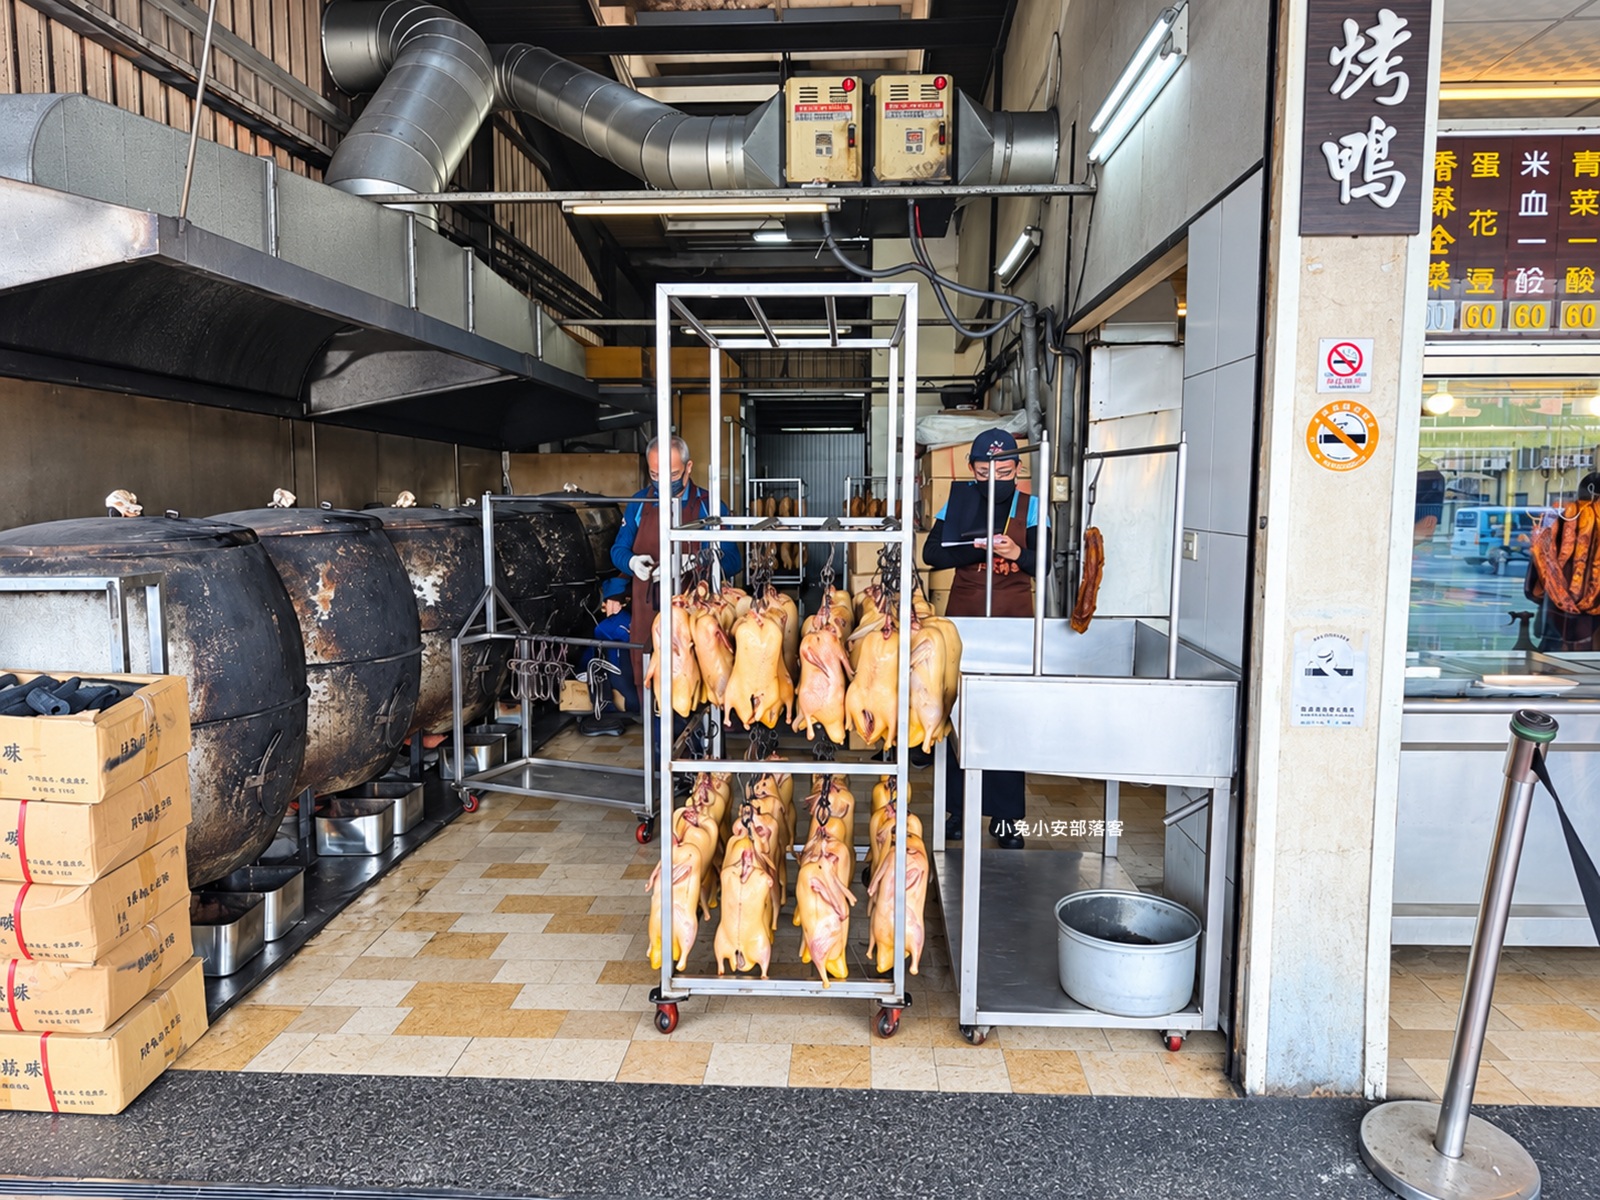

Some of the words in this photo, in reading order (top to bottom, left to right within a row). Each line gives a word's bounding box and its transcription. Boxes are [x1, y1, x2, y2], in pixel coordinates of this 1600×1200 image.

[1321, 8, 1412, 209] 烤鴨
[1465, 304, 1496, 329] 60
[1514, 304, 1546, 329] 60
[1565, 304, 1597, 329] 60
